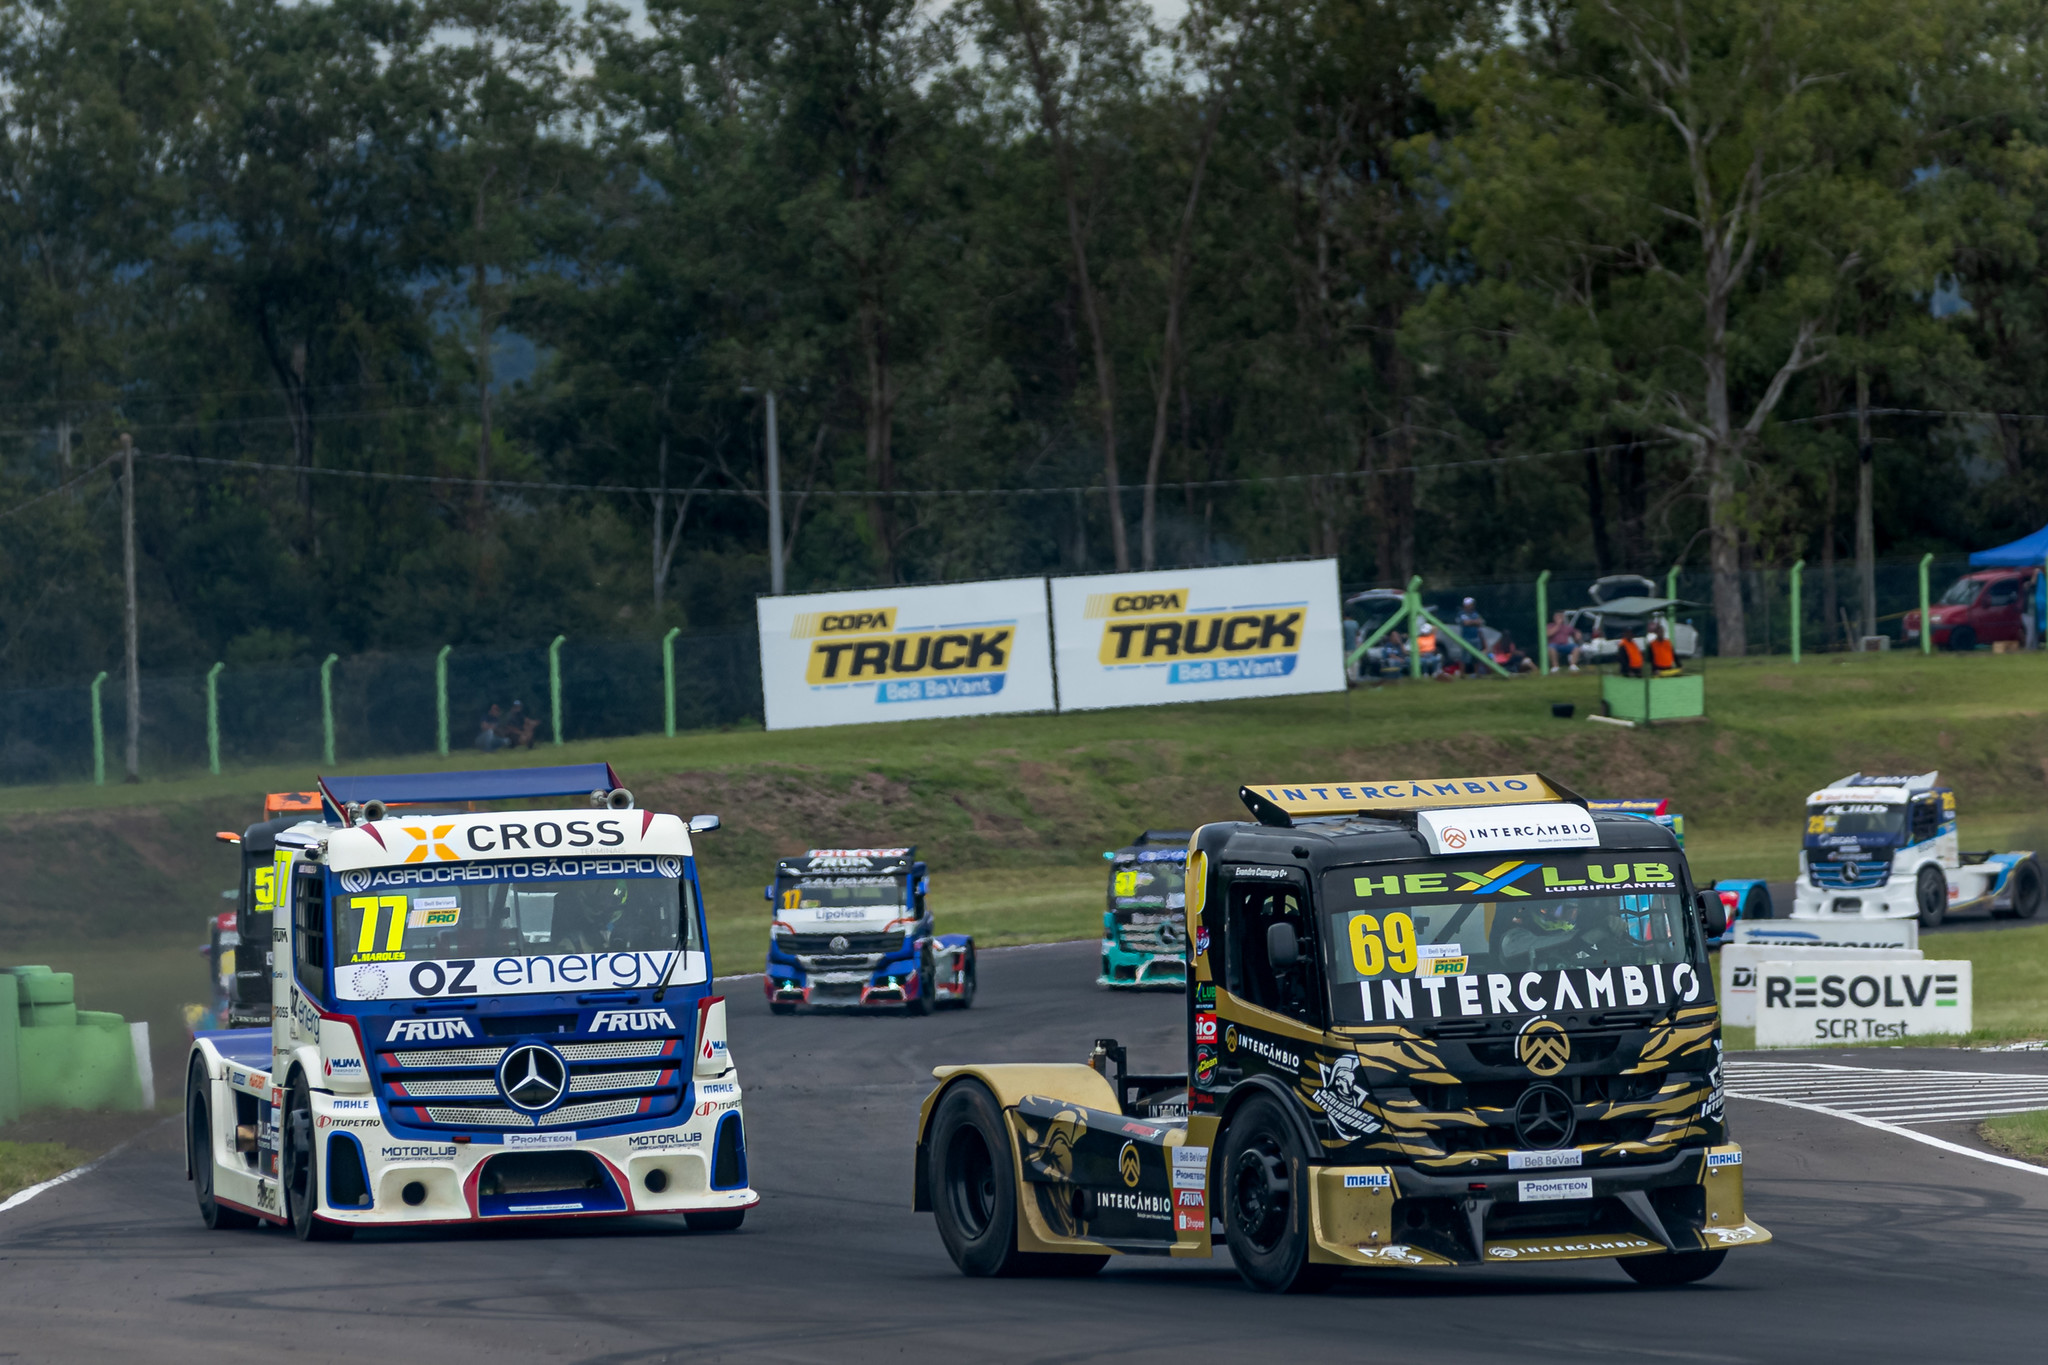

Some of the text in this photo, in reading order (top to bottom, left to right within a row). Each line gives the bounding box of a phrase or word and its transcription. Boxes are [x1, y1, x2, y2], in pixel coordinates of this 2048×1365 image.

[1113, 593, 1181, 612] COPA
[821, 611, 888, 632] COPA
[1108, 611, 1302, 659] TRUCK
[815, 630, 1010, 679] TRUCK
[1179, 656, 1284, 681] Be8 BeVant
[886, 677, 991, 701] Be8 BeVant
[467, 820, 625, 852] CROSS
[372, 858, 655, 887] AGROCRÉDITO SÃO PEDRO
[1545, 882, 1676, 893] LUBRIFICANTES
[350, 895, 408, 953] 77
[426, 913, 456, 924] PRO
[1348, 912, 1418, 976] 69
[351, 951, 406, 963] A.MARQUES
[409, 952, 673, 996] OZ energy
[1434, 963, 1464, 973] PRO
[1766, 974, 1957, 1008] RESOLVE
[588, 1008, 676, 1033] FRUM
[1815, 1018, 1909, 1039] SCR Test
[385, 1017, 474, 1042] FRUM
[703, 1083, 734, 1094] MAHLE
[333, 1100, 369, 1109] MAHLE
[331, 1119, 381, 1127] ITUPETRO
[510, 1134, 572, 1144] PROMETEON
[629, 1132, 703, 1146] MOTORLUB
[382, 1146, 457, 1157] MOTORLUB
[1709, 1153, 1742, 1165] MAHLE
[1524, 1154, 1580, 1167] Be8 BeVant
[1346, 1175, 1388, 1187] MAHLE
[1524, 1182, 1588, 1192] PROMETEON
[1178, 1191, 1204, 1207] FRUM
[1187, 1217, 1204, 1231] Shopee
